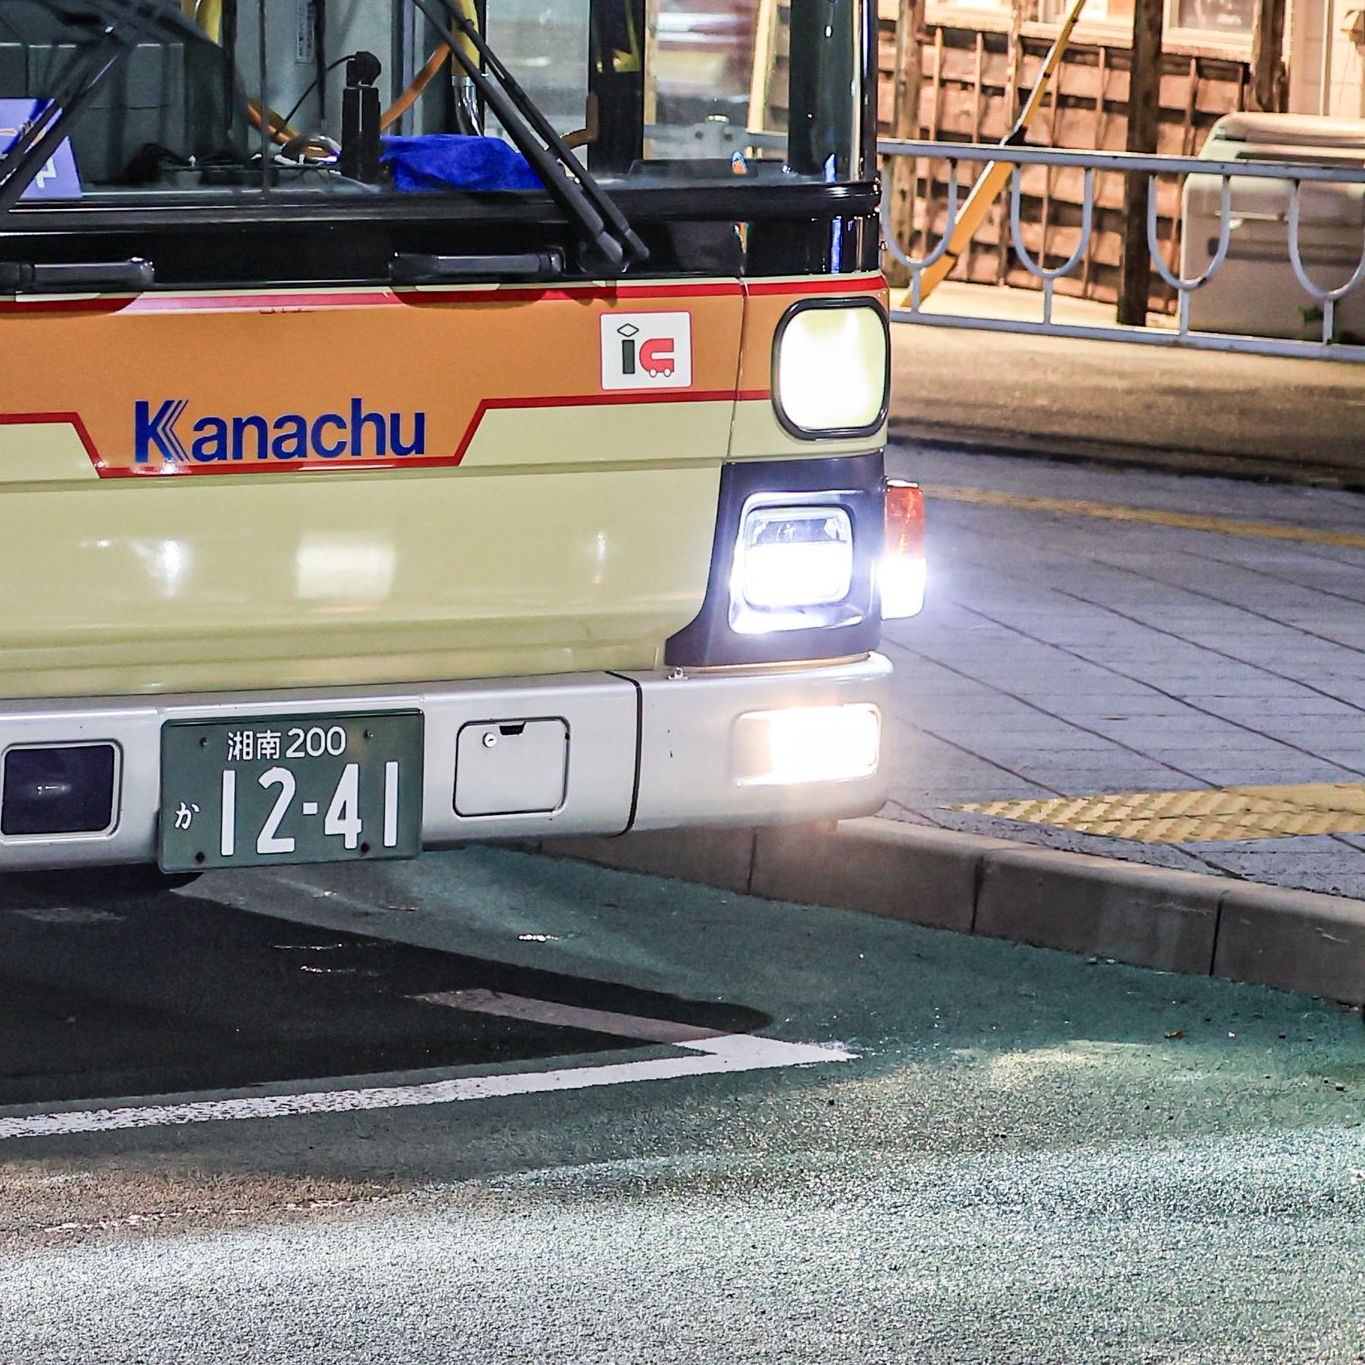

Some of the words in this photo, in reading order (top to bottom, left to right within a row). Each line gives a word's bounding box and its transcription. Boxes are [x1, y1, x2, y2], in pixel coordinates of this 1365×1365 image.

[135, 397, 426, 463] Kanachu
[174, 801, 200, 831] か
[220, 760, 400, 857] 12-41
